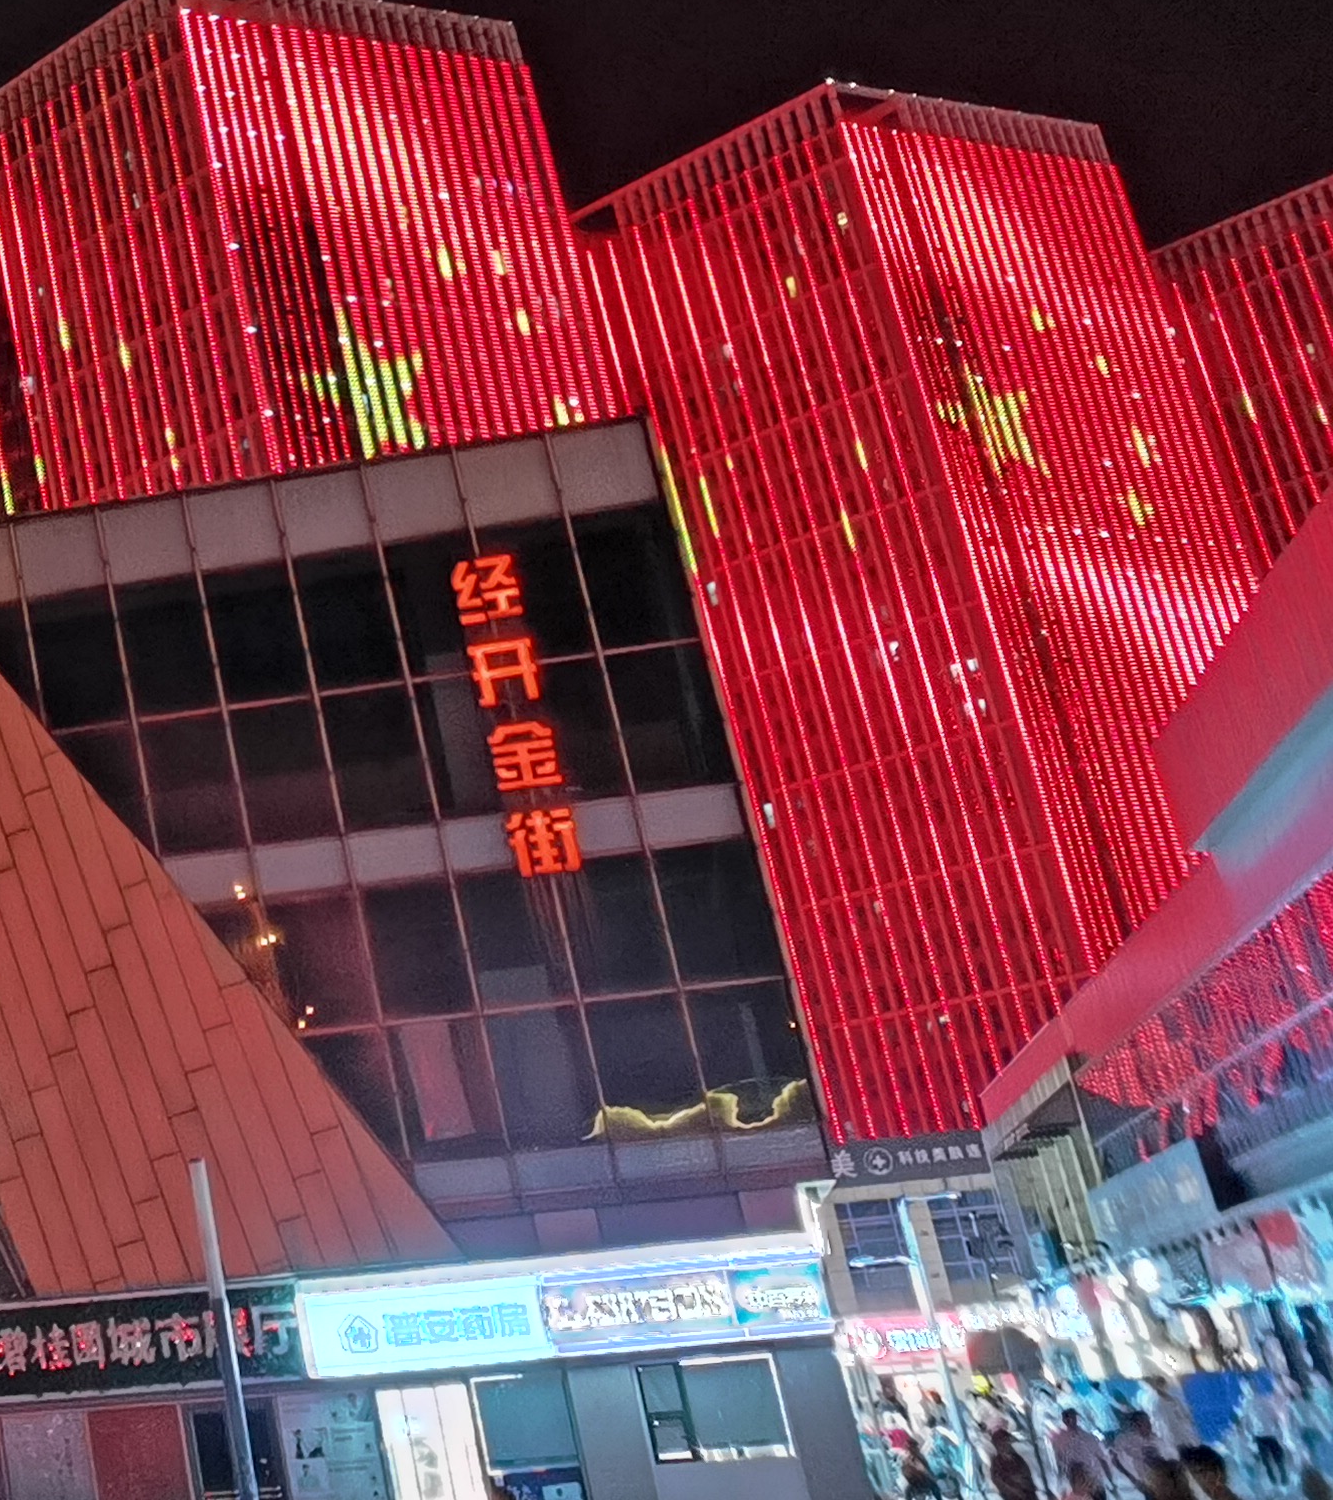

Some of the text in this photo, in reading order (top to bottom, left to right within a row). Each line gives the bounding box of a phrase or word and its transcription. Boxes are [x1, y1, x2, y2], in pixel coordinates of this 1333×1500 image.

[450, 553, 583, 878] 经开金街
[546, 1280, 730, 1332] LAWSON
